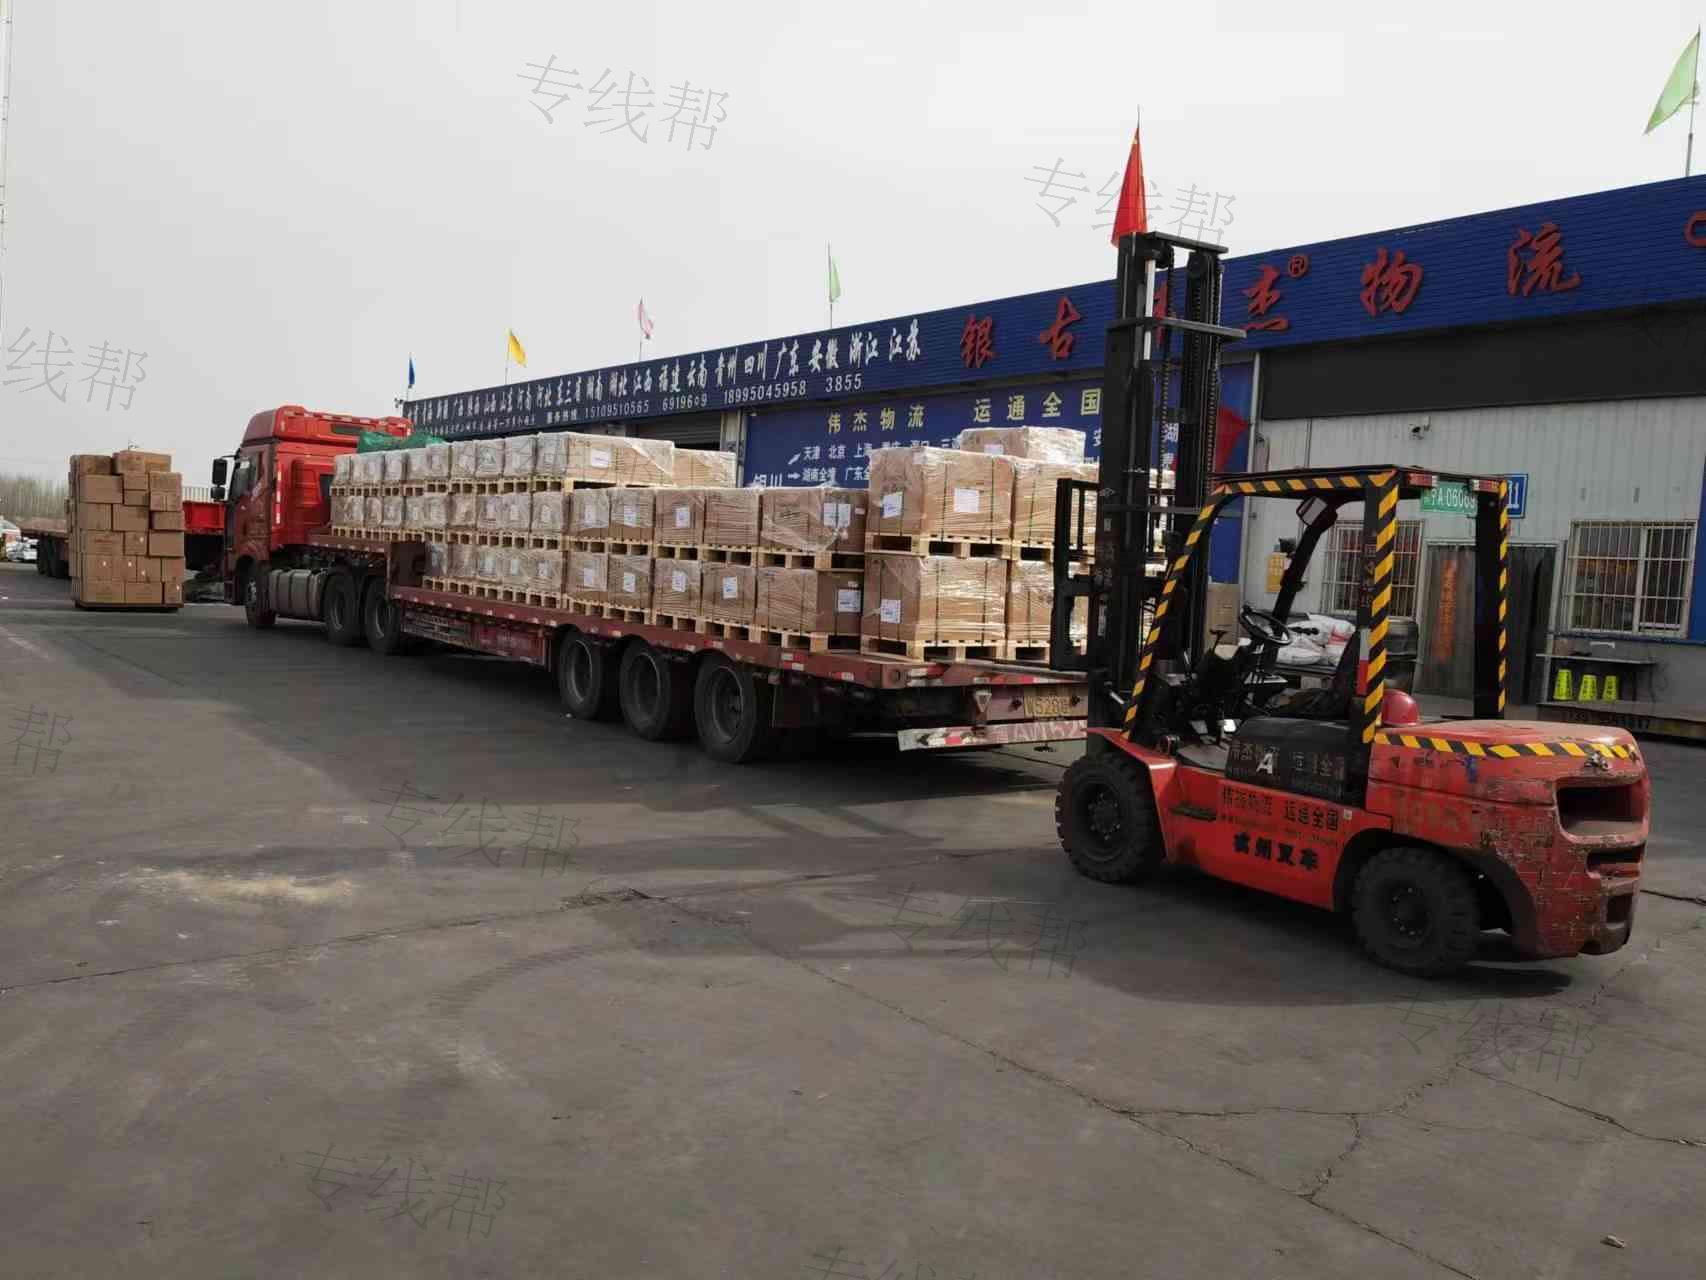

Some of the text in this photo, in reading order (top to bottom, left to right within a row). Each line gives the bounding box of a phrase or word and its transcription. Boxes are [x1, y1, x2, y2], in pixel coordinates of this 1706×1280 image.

[744, 342, 767, 381] 四川
[774, 338, 799, 380] 广东
[808, 337, 839, 373] 安徽
[850, 331, 878, 368] 浙江
[888, 318, 921, 361] 江苏
[723, 380, 807, 405] 18995045958
[825, 373, 862, 393] 3855
[828, 387, 1102, 434] 伟杰物流 运通全国
[828, 444, 846, 459] 北京
